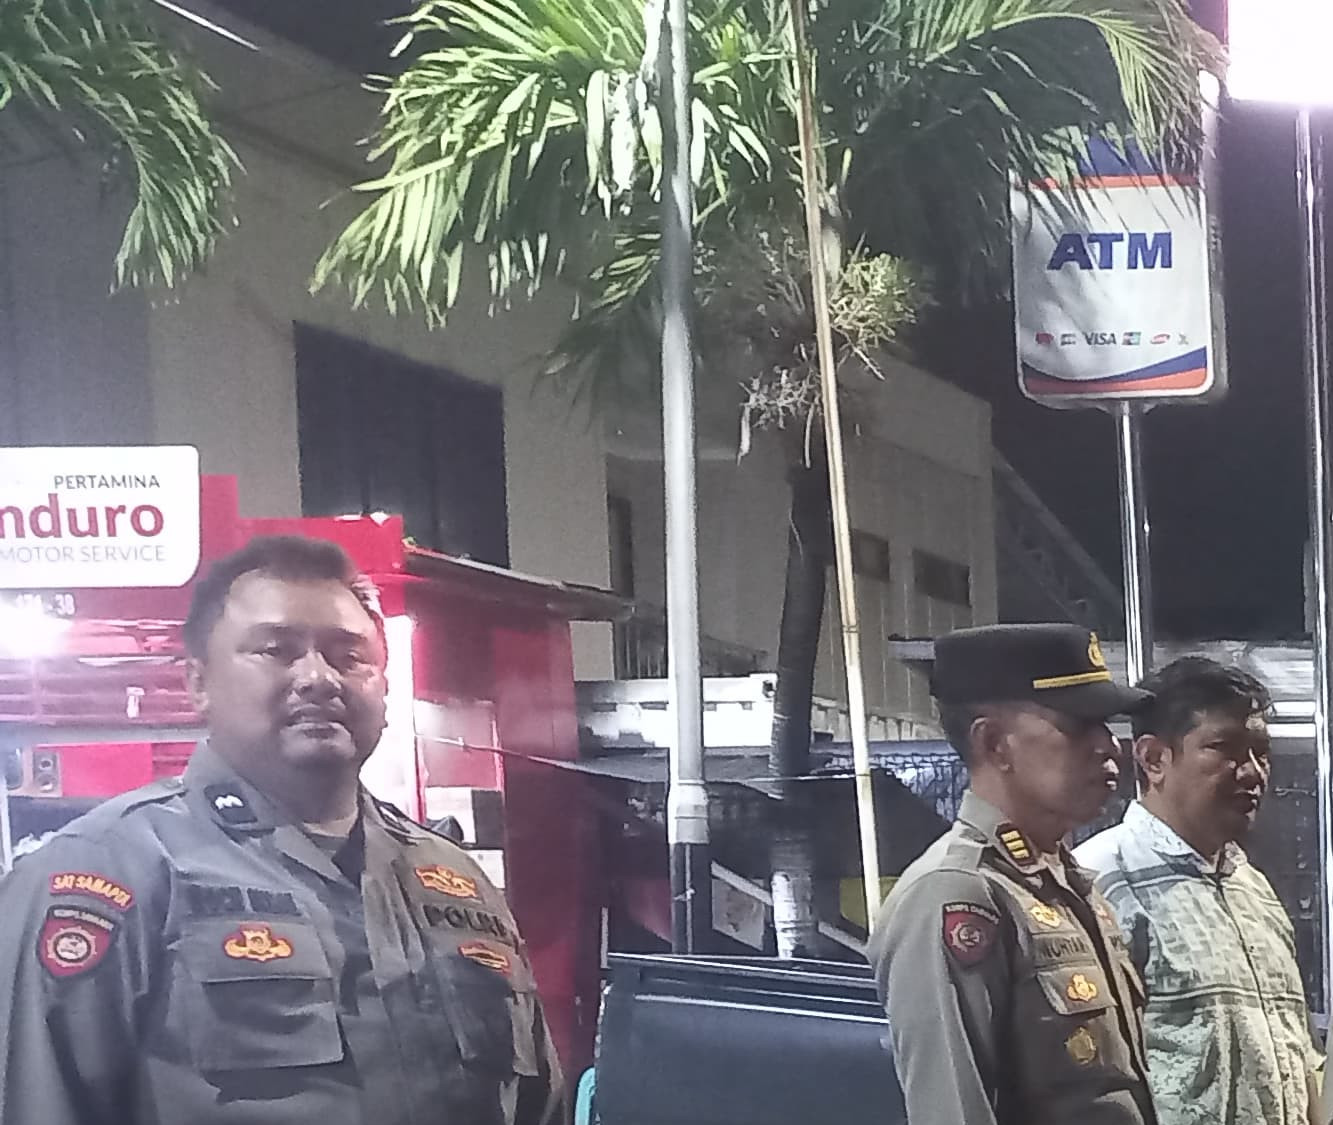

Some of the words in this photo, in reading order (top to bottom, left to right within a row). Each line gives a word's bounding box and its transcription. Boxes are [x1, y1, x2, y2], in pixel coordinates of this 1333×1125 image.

[1046, 231, 1173, 271] ATM
[1083, 331, 1117, 346] VISA
[53, 474, 161, 490] PERTAMINA
[0, 492, 165, 540] nduro
[80, 545, 167, 563] SERVICE
